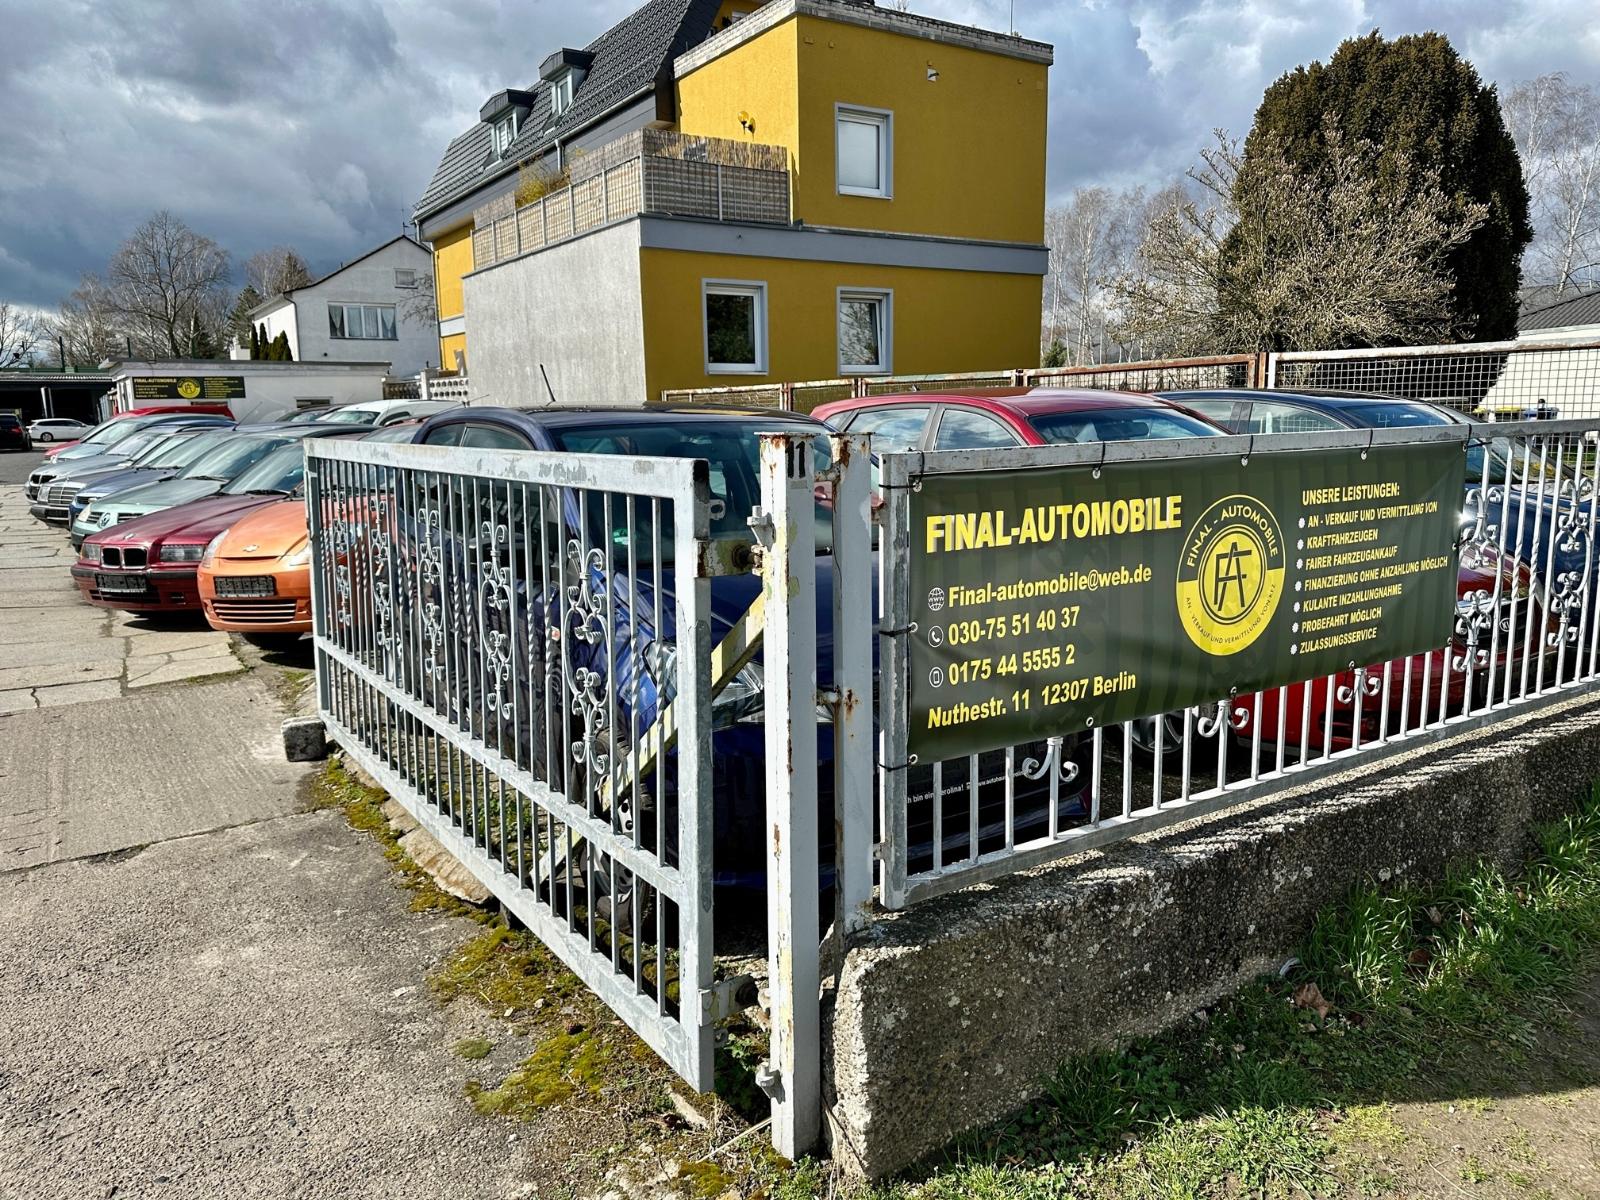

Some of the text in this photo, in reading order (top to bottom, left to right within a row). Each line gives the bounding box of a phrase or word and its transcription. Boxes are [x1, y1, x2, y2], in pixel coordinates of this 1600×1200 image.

[785, 440, 806, 479] 11
[1302, 482, 1400, 506] UNSERE LEISTUNGEN:
[926, 495, 1182, 553] FINAL-AUTOMOBILE
[1307, 515, 1319, 528] AN
[1324, 510, 1359, 526] VERKAUF
[1360, 508, 1376, 522] UND
[1377, 502, 1424, 520] VERMITTLUNG
[1424, 501, 1438, 513] VON
[1187, 524, 1213, 567] FINAL
[1221, 504, 1279, 558] AUTOMOBILE
[1306, 528, 1379, 549] KRAFTFAHRZEUGEN
[1304, 555, 1448, 591] FINANZIERUNG OHNE ANZAHLUNG MÖGLICH
[1305, 545, 1398, 571] FAIRER FAHRZEUGANKAUF
[948, 563, 1152, 608] Final-automobile@web.de
[1302, 583, 1402, 613] KULANTE INZAHLUNGNAHME
[948, 606, 1080, 646] 030-75 51 40 37
[1191, 613, 1211, 638] VERKAUF
[1210, 635, 1224, 643] UND
[1224, 617, 1261, 643] VERMITTLUNG
[1260, 599, 1271, 615] VON
[1301, 606, 1382, 634] PROBEFAHRT MÖGLICH
[1299, 627, 1378, 654] ZULASSUNGSSERVICE
[948, 643, 1075, 686] 0175 44 5555 2
[927, 670, 1136, 729] Nuthestr. 11 12307 Berlin
